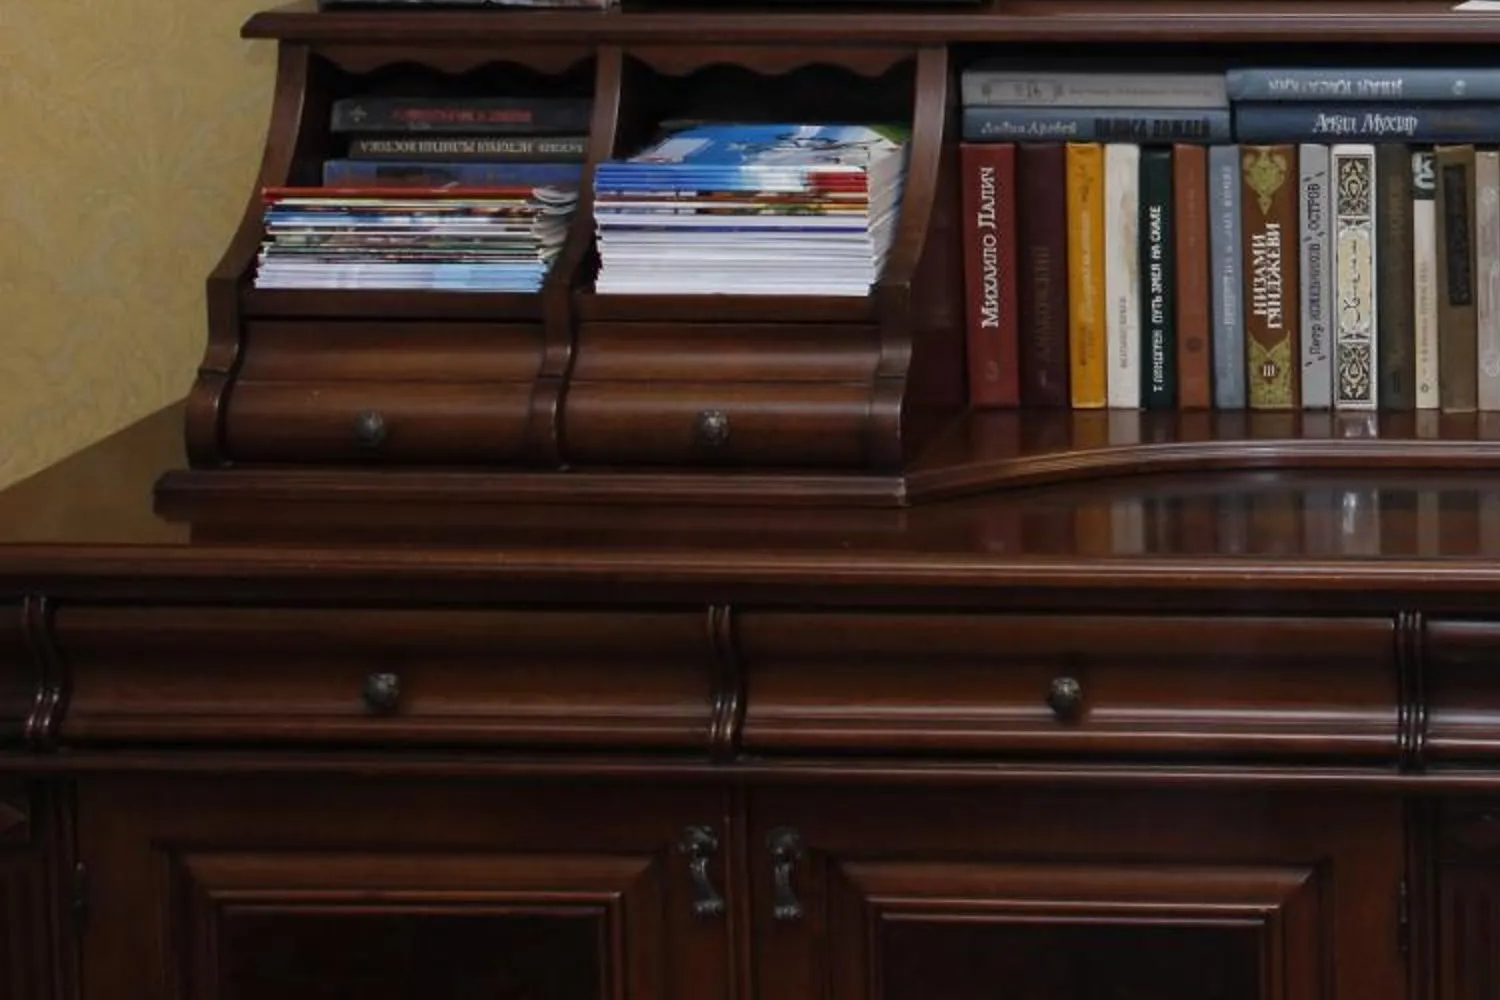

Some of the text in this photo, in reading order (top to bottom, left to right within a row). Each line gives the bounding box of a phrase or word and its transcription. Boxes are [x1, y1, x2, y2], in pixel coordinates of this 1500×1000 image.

[1149, 205, 1162, 242] СКАЛЕ
[1307, 183, 1320, 231] ОСТРОВ
[1150, 244, 1162, 259] НА
[1252, 234, 1267, 316] НИЗАМИ
[1266, 223, 1282, 330] ГЯНДЖЕВИ
[1151, 296, 1163, 324] ПУТЬ
